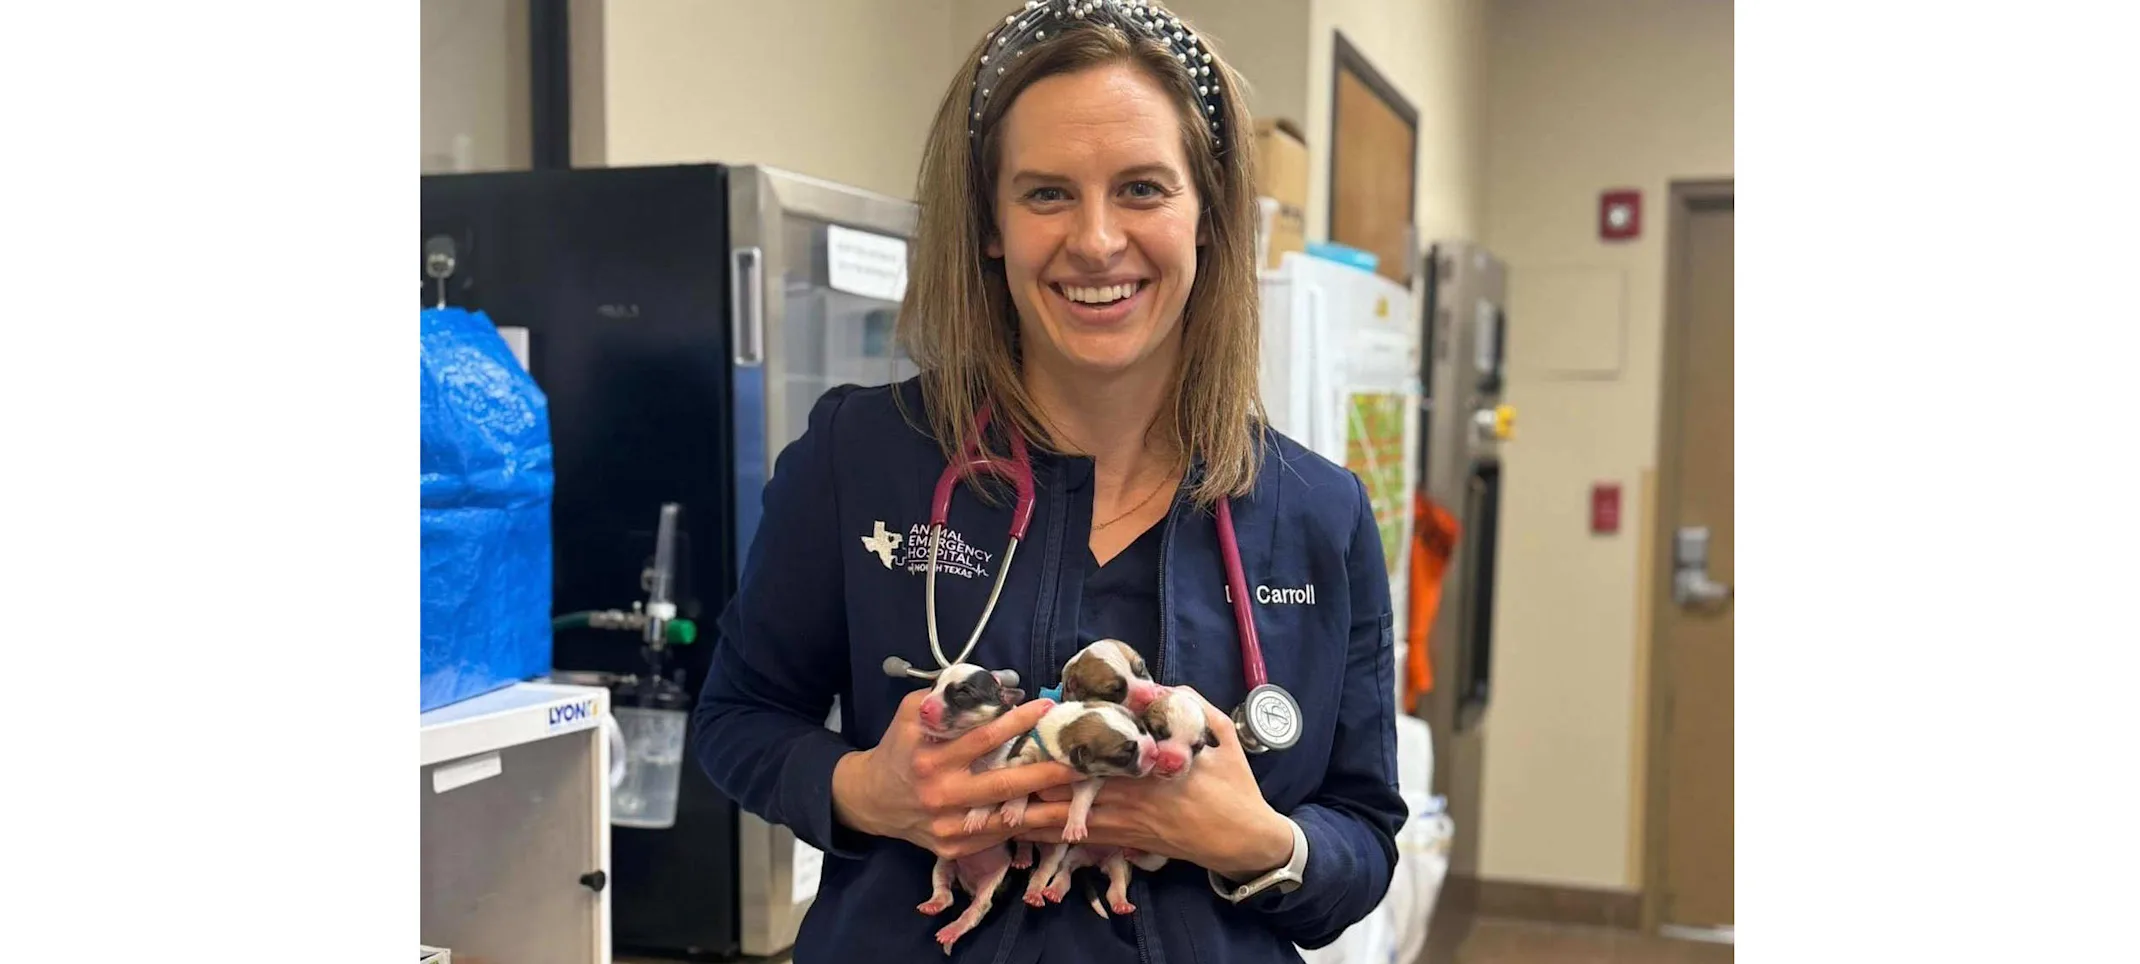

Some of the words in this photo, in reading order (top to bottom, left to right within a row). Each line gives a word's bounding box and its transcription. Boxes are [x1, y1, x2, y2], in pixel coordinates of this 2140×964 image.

[909, 523, 964, 543] ANMAL
[943, 565, 974, 579] TEXAS
[1256, 584, 1316, 604] Carroll
[549, 701, 585, 725] LYON
